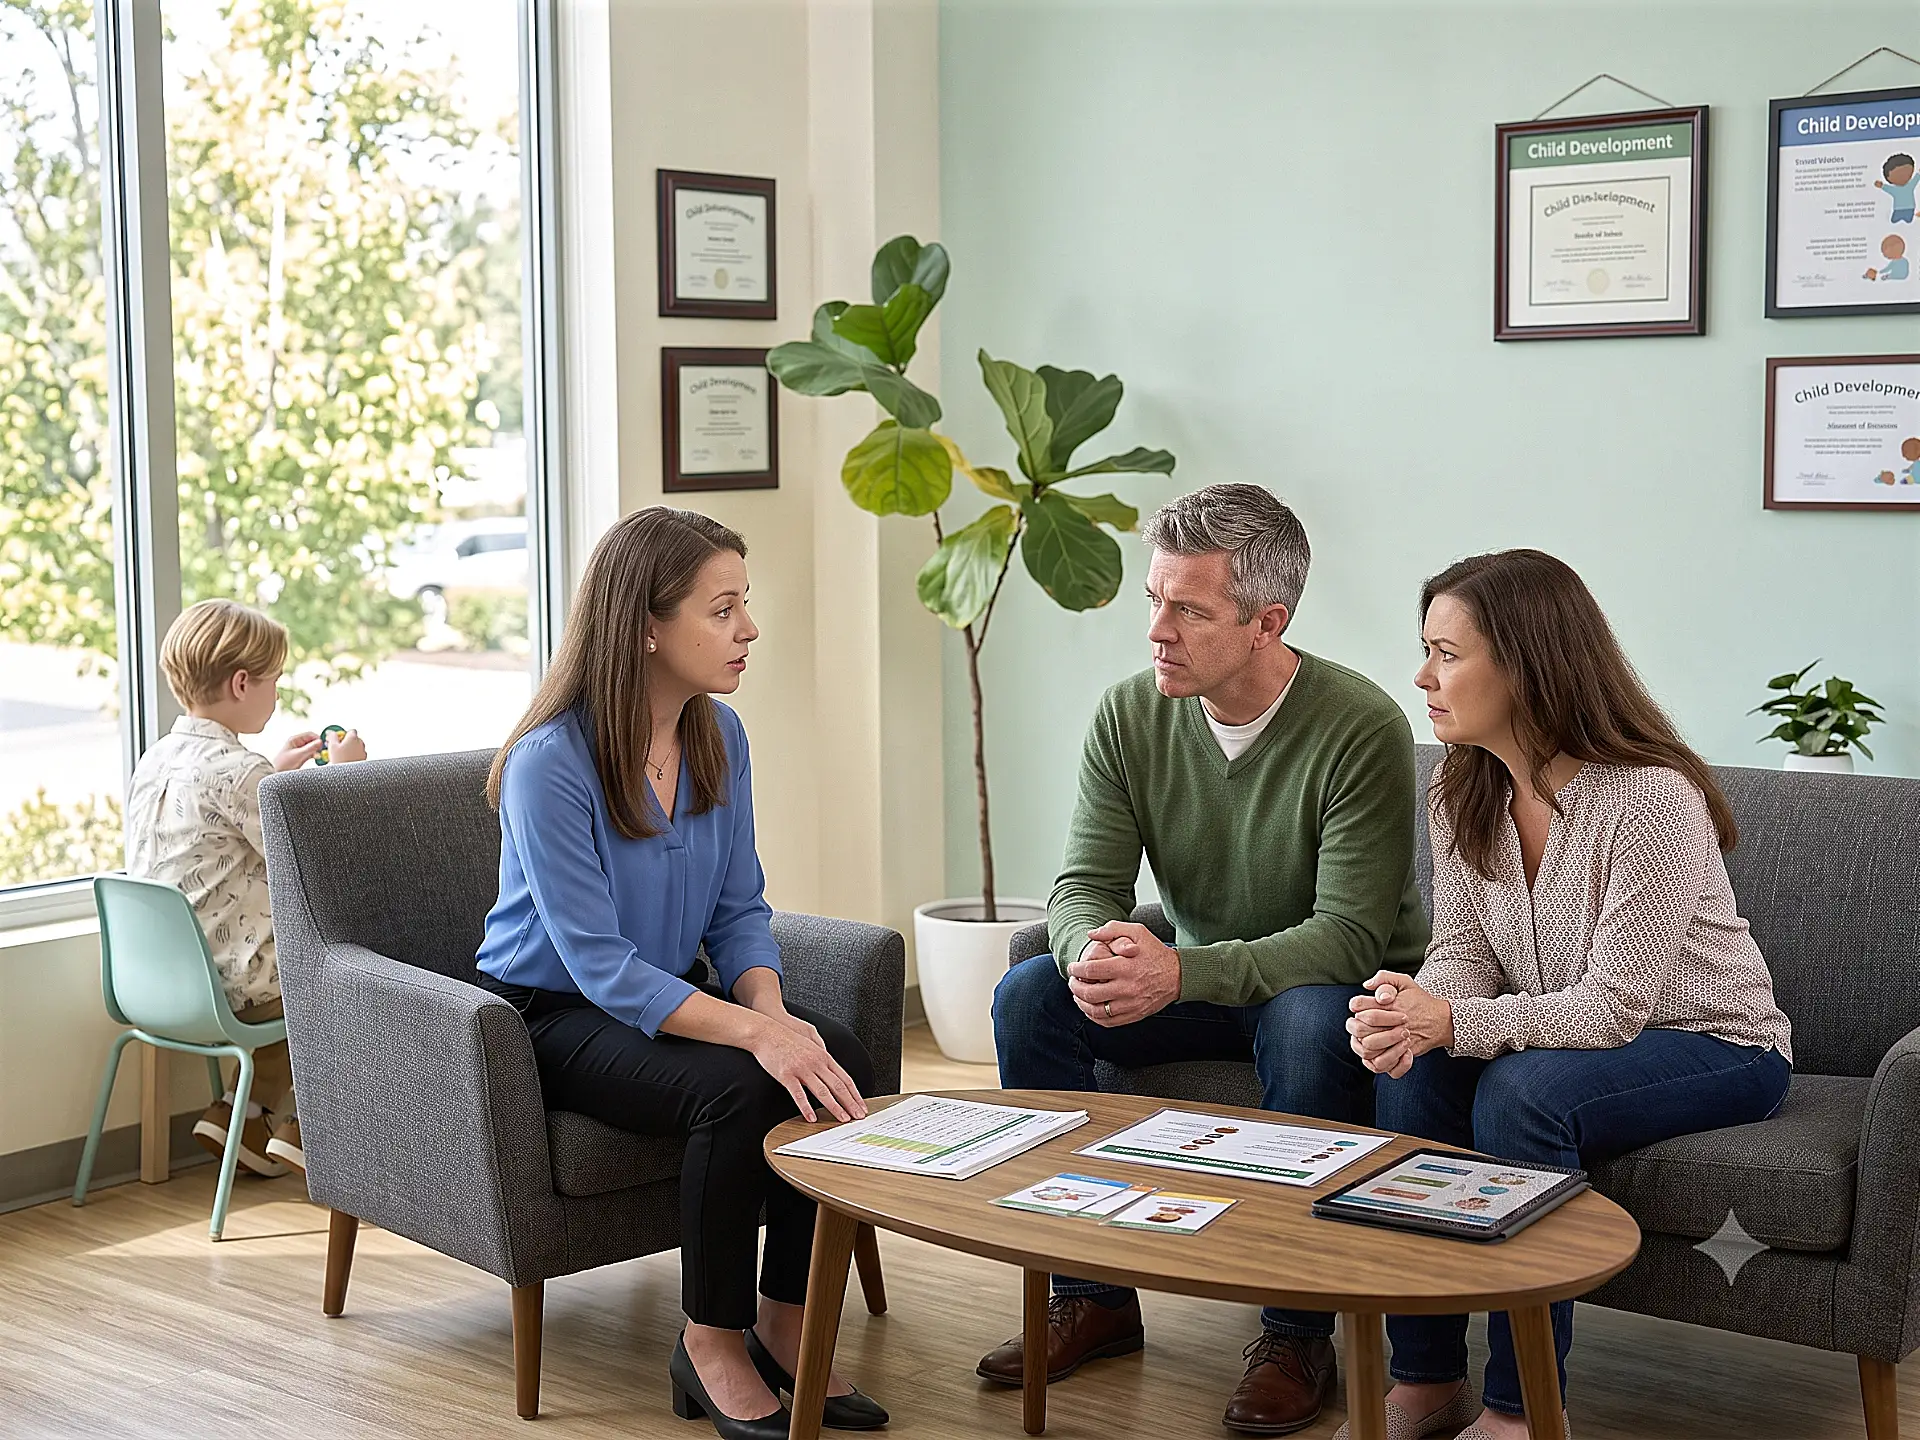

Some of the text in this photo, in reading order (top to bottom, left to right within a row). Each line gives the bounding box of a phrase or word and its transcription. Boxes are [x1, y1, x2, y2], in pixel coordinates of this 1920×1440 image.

[1798, 111, 1920, 134] Child Develop
[1528, 134, 1673, 159] Child Development
[1794, 383, 1830, 403] Child
